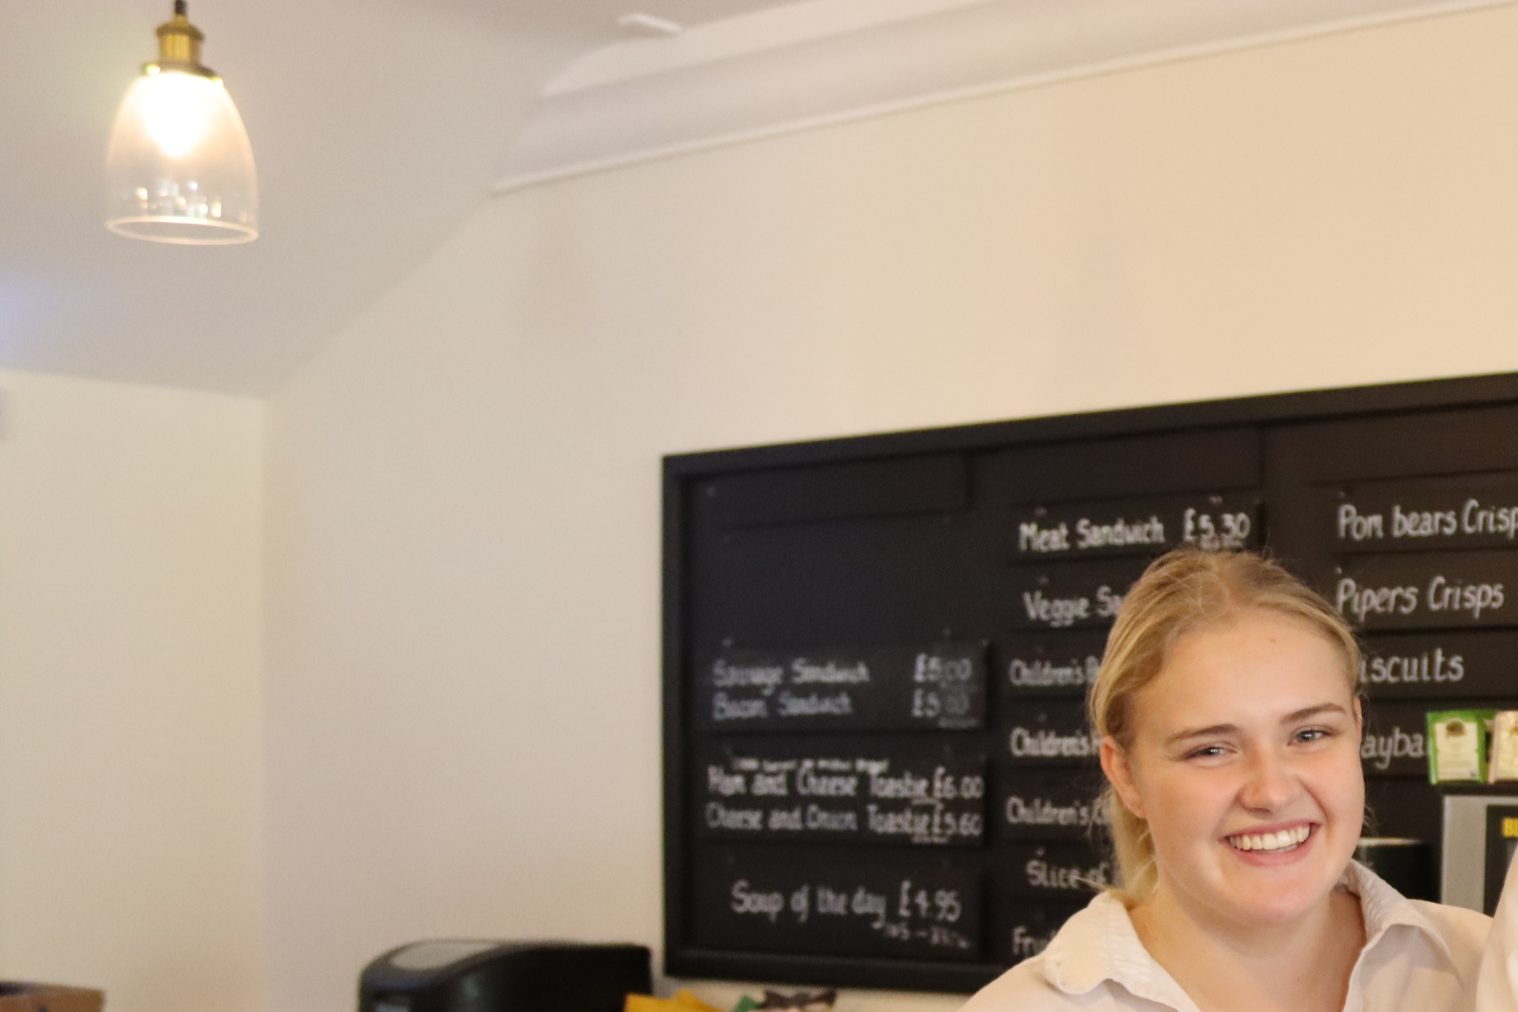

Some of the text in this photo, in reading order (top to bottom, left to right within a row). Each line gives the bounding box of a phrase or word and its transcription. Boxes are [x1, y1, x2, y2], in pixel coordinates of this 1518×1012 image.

[1020, 522, 1070, 550] Meat
[1077, 516, 1165, 548] Sandwich
[1338, 504, 1384, 541] Pom
[1392, 506, 1458, 538] bears
[1023, 590, 1090, 626] Veggie
[1337, 578, 1418, 623] Pipers
[1428, 576, 1504, 619] Crisps
[1361, 648, 1464, 683] iscuits
[1362, 728, 1424, 769] ayba
[752, 774, 787, 795] and
[768, 808, 802, 830] and
[1026, 860, 1080, 889] Slice
[732, 880, 783, 922] Soup
[791, 885, 809, 922] of
[817, 887, 847, 914] the
[852, 887, 887, 929] day
